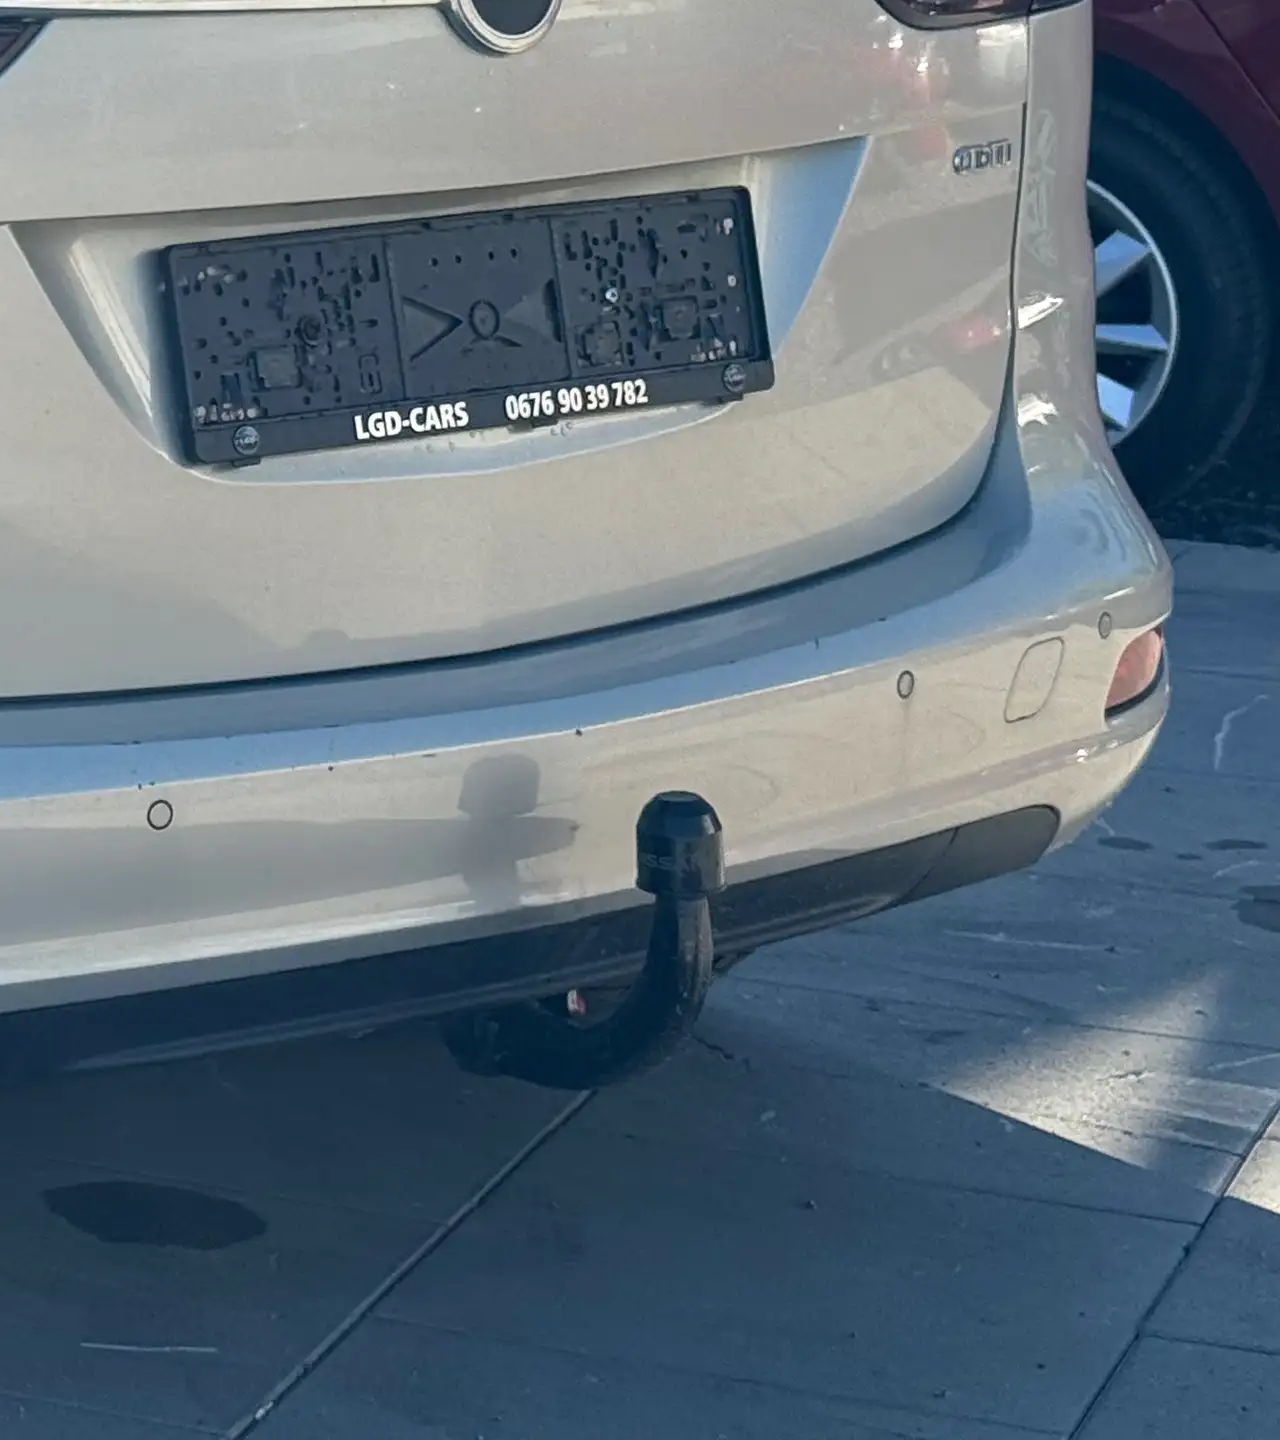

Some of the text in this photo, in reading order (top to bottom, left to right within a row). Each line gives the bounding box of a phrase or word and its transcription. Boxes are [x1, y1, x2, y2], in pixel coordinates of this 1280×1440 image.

[354, 379, 649, 441] LGD-CARS 0676 90 39 782
